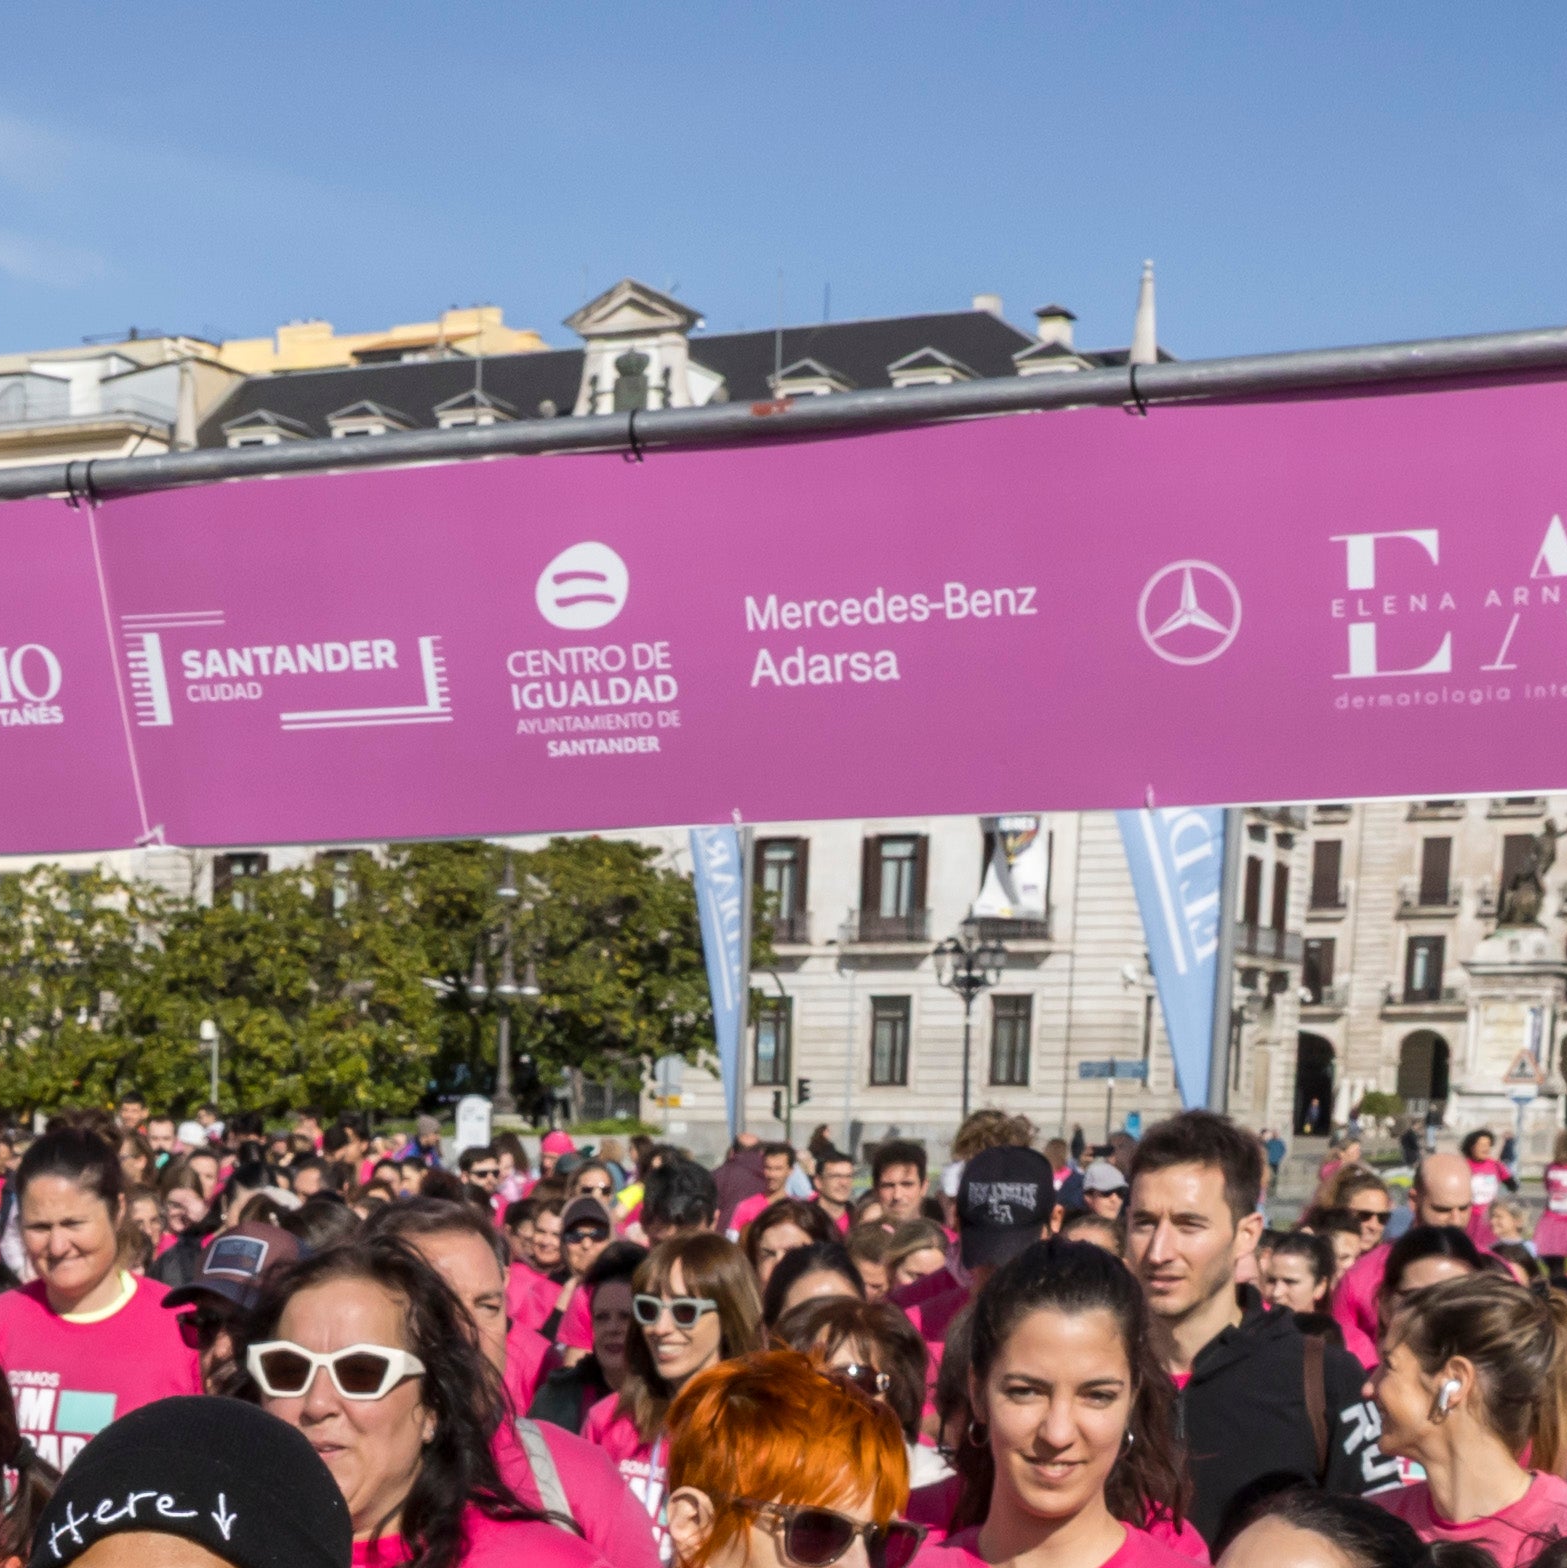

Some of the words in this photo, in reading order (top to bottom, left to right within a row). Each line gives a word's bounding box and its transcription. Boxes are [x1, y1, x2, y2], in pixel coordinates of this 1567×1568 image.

[745, 581, 1038, 632] Mercedes-Benz
[1331, 592, 1456, 618] ELENA
[181, 638, 399, 680] SANTANDER
[507, 644, 627, 678] CENTRO
[632, 641, 673, 671] DE
[750, 646, 901, 688] Adarsa
[187, 682, 263, 703] CIUDAD
[511, 674, 679, 711] IGUALDAD
[516, 712, 653, 735] AYUNTAMIENTO
[657, 709, 682, 728] DE
[547, 736, 661, 758] SANTANDER
[48, 1491, 198, 1558] Here
